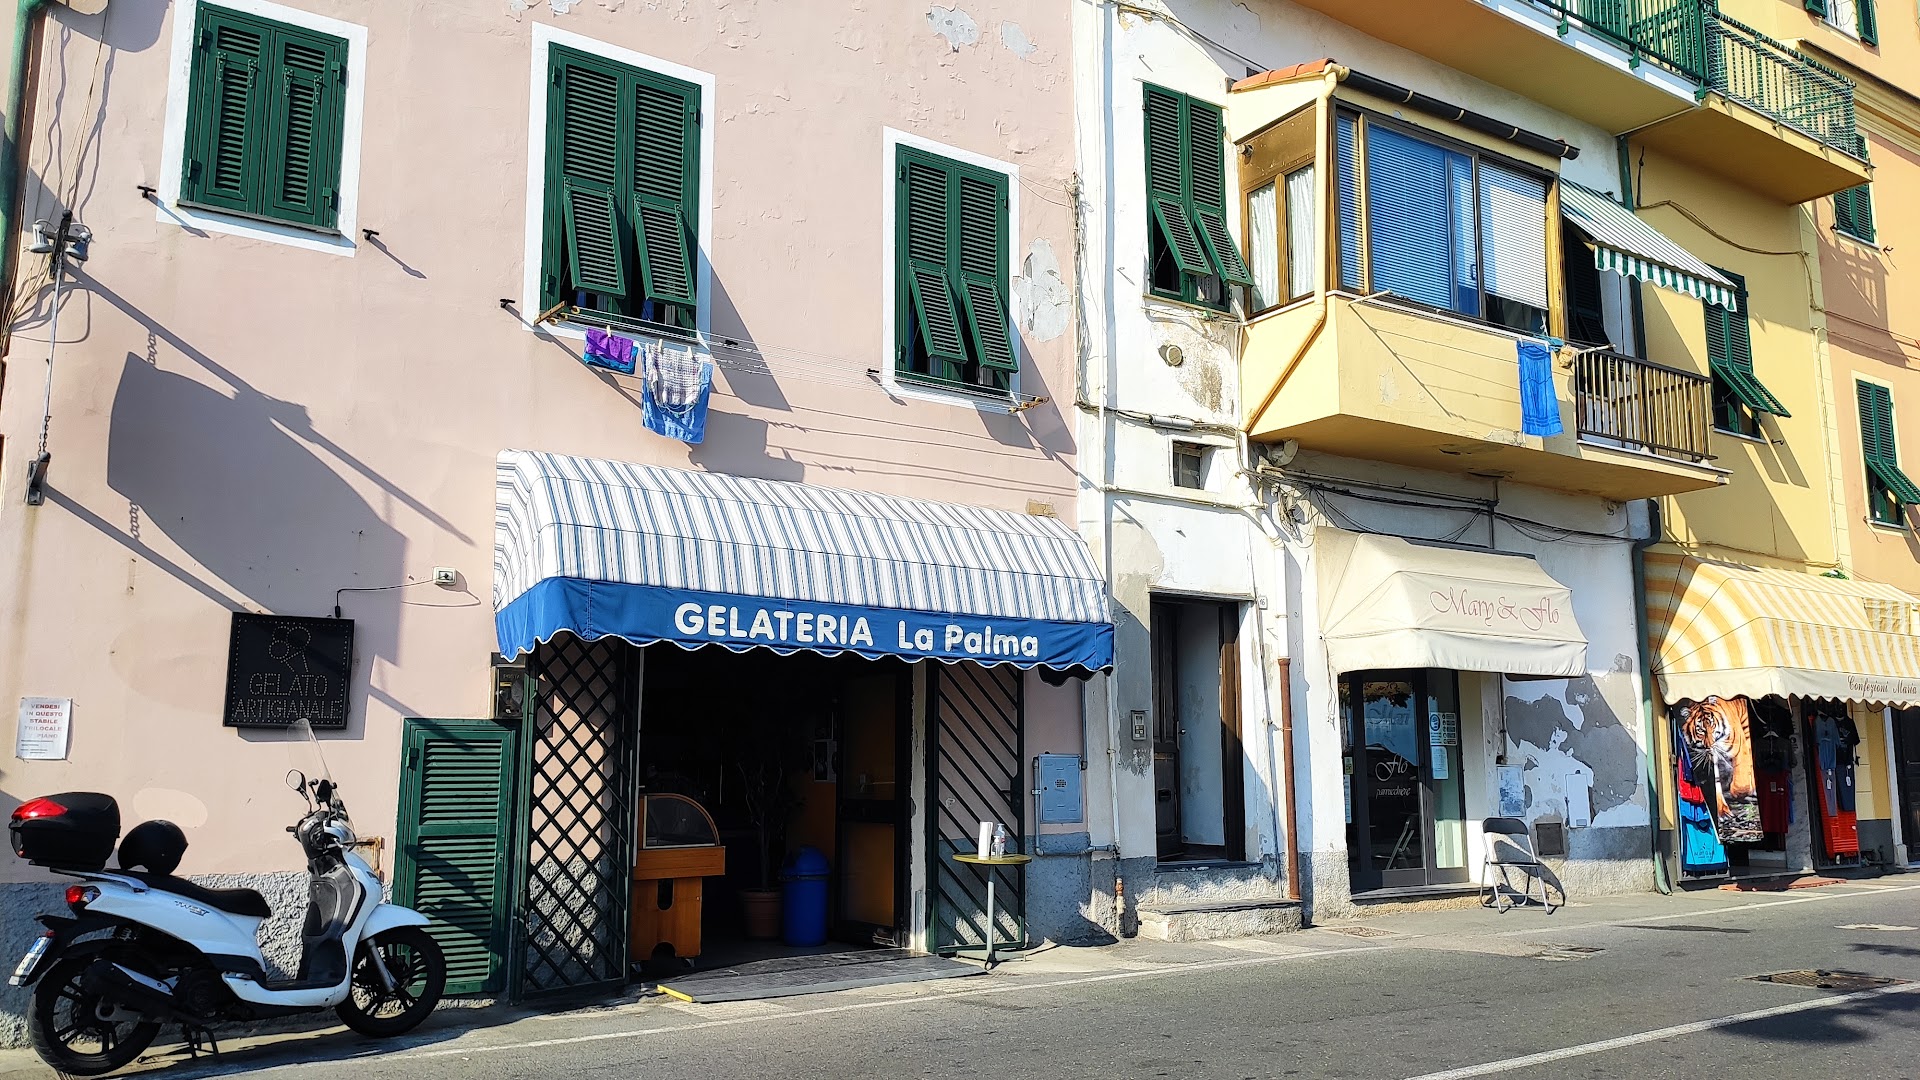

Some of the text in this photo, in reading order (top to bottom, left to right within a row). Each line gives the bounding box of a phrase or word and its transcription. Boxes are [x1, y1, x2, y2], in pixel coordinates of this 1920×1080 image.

[1429, 586, 1560, 632] Mary & Flo
[674, 602, 1039, 657] GELATERIA La Palma
[249, 672, 328, 697] GELATO
[1847, 674, 1917, 698] Confezioni Maria
[233, 698, 341, 719] ARTIGIANALE
[1375, 753, 1409, 782] Flo
